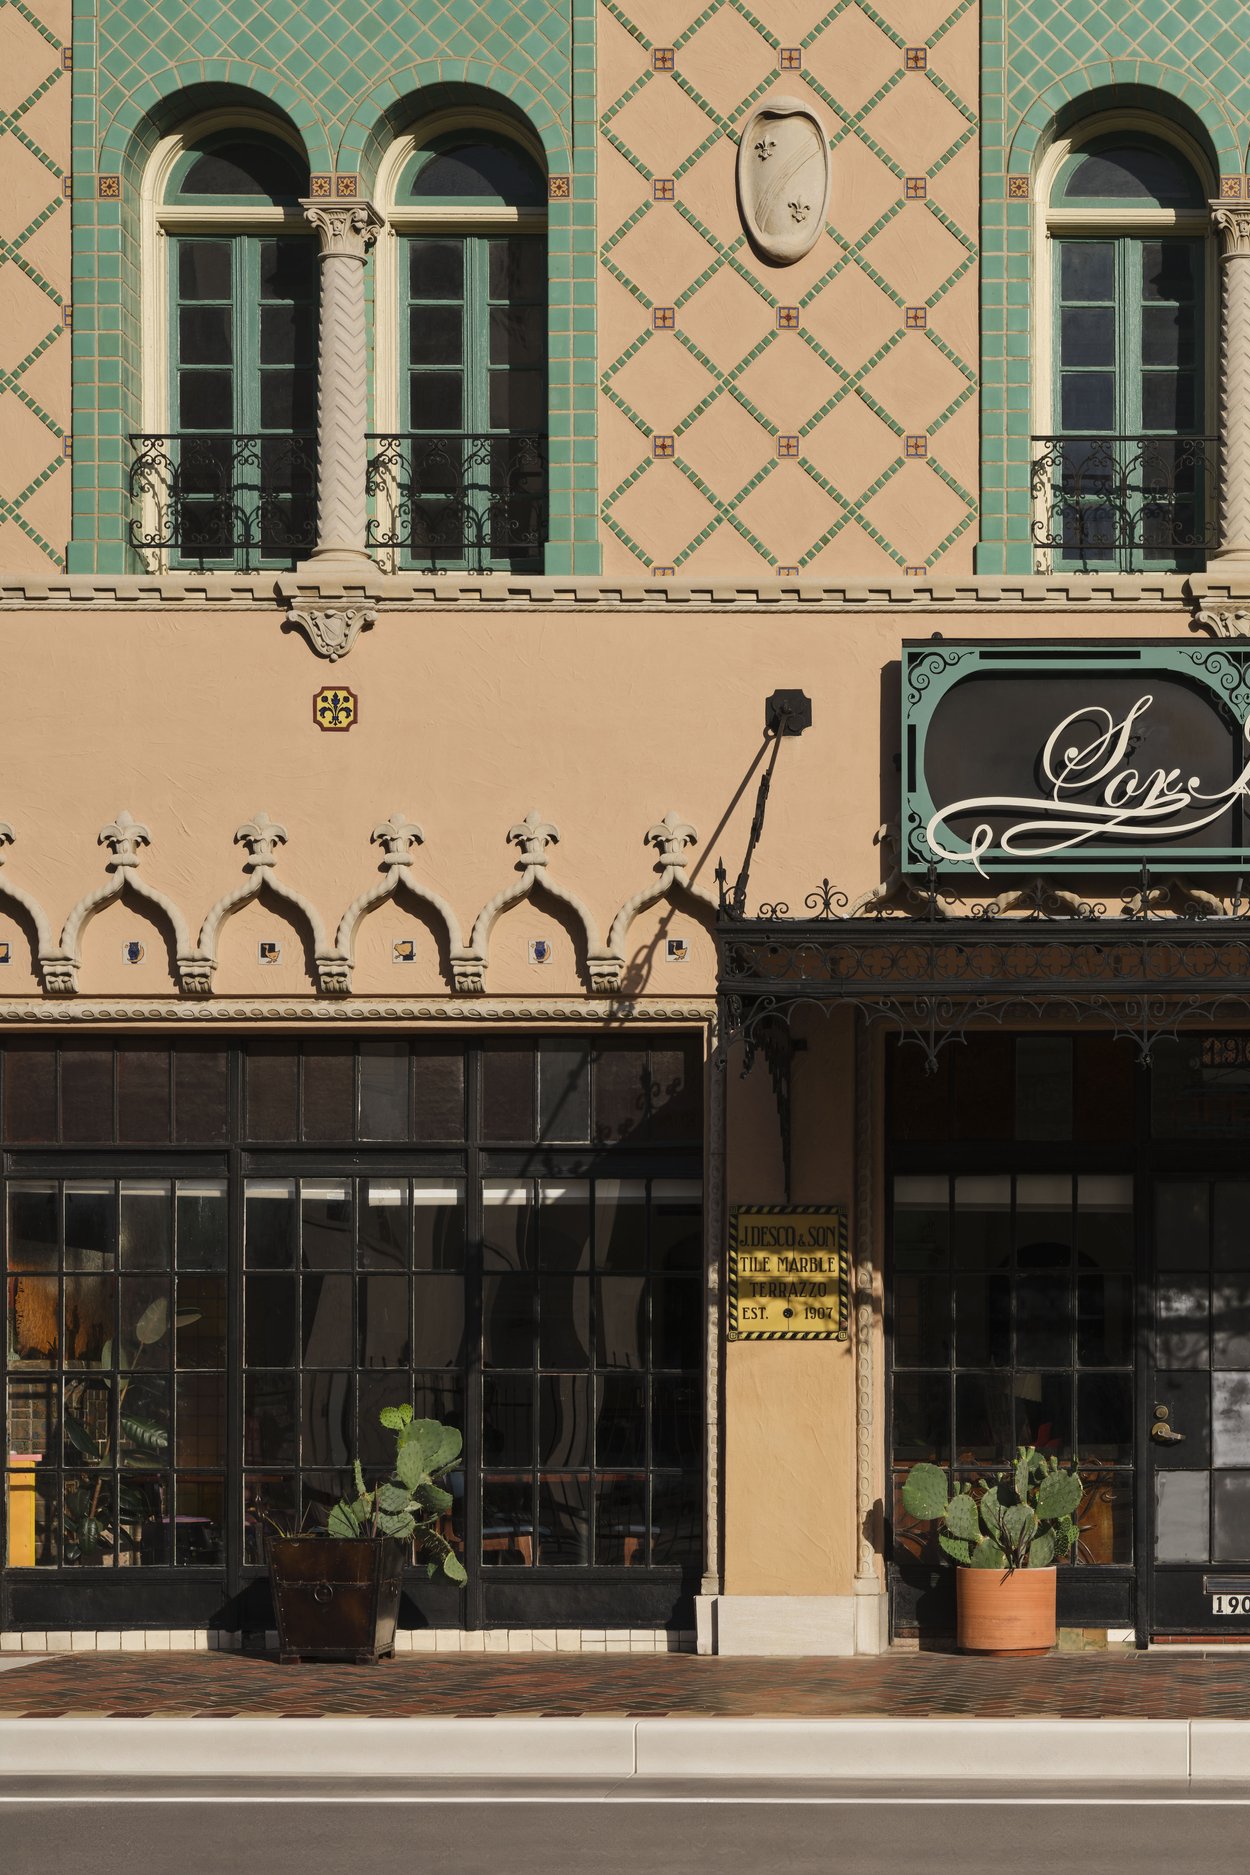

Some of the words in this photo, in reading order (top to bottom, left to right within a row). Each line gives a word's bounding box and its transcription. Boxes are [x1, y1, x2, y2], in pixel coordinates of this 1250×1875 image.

[1041, 694, 1189, 808] Sor
[797, 1233, 807, 1247] &
[808, 1226, 836, 1247] SON
[740, 1256, 771, 1273] TILE
[777, 1256, 836, 1273] MARBLE
[750, 1281, 827, 1298] TERRAZZO
[742, 1307, 769, 1320] EST.
[804, 1307, 833, 1320] 1907
